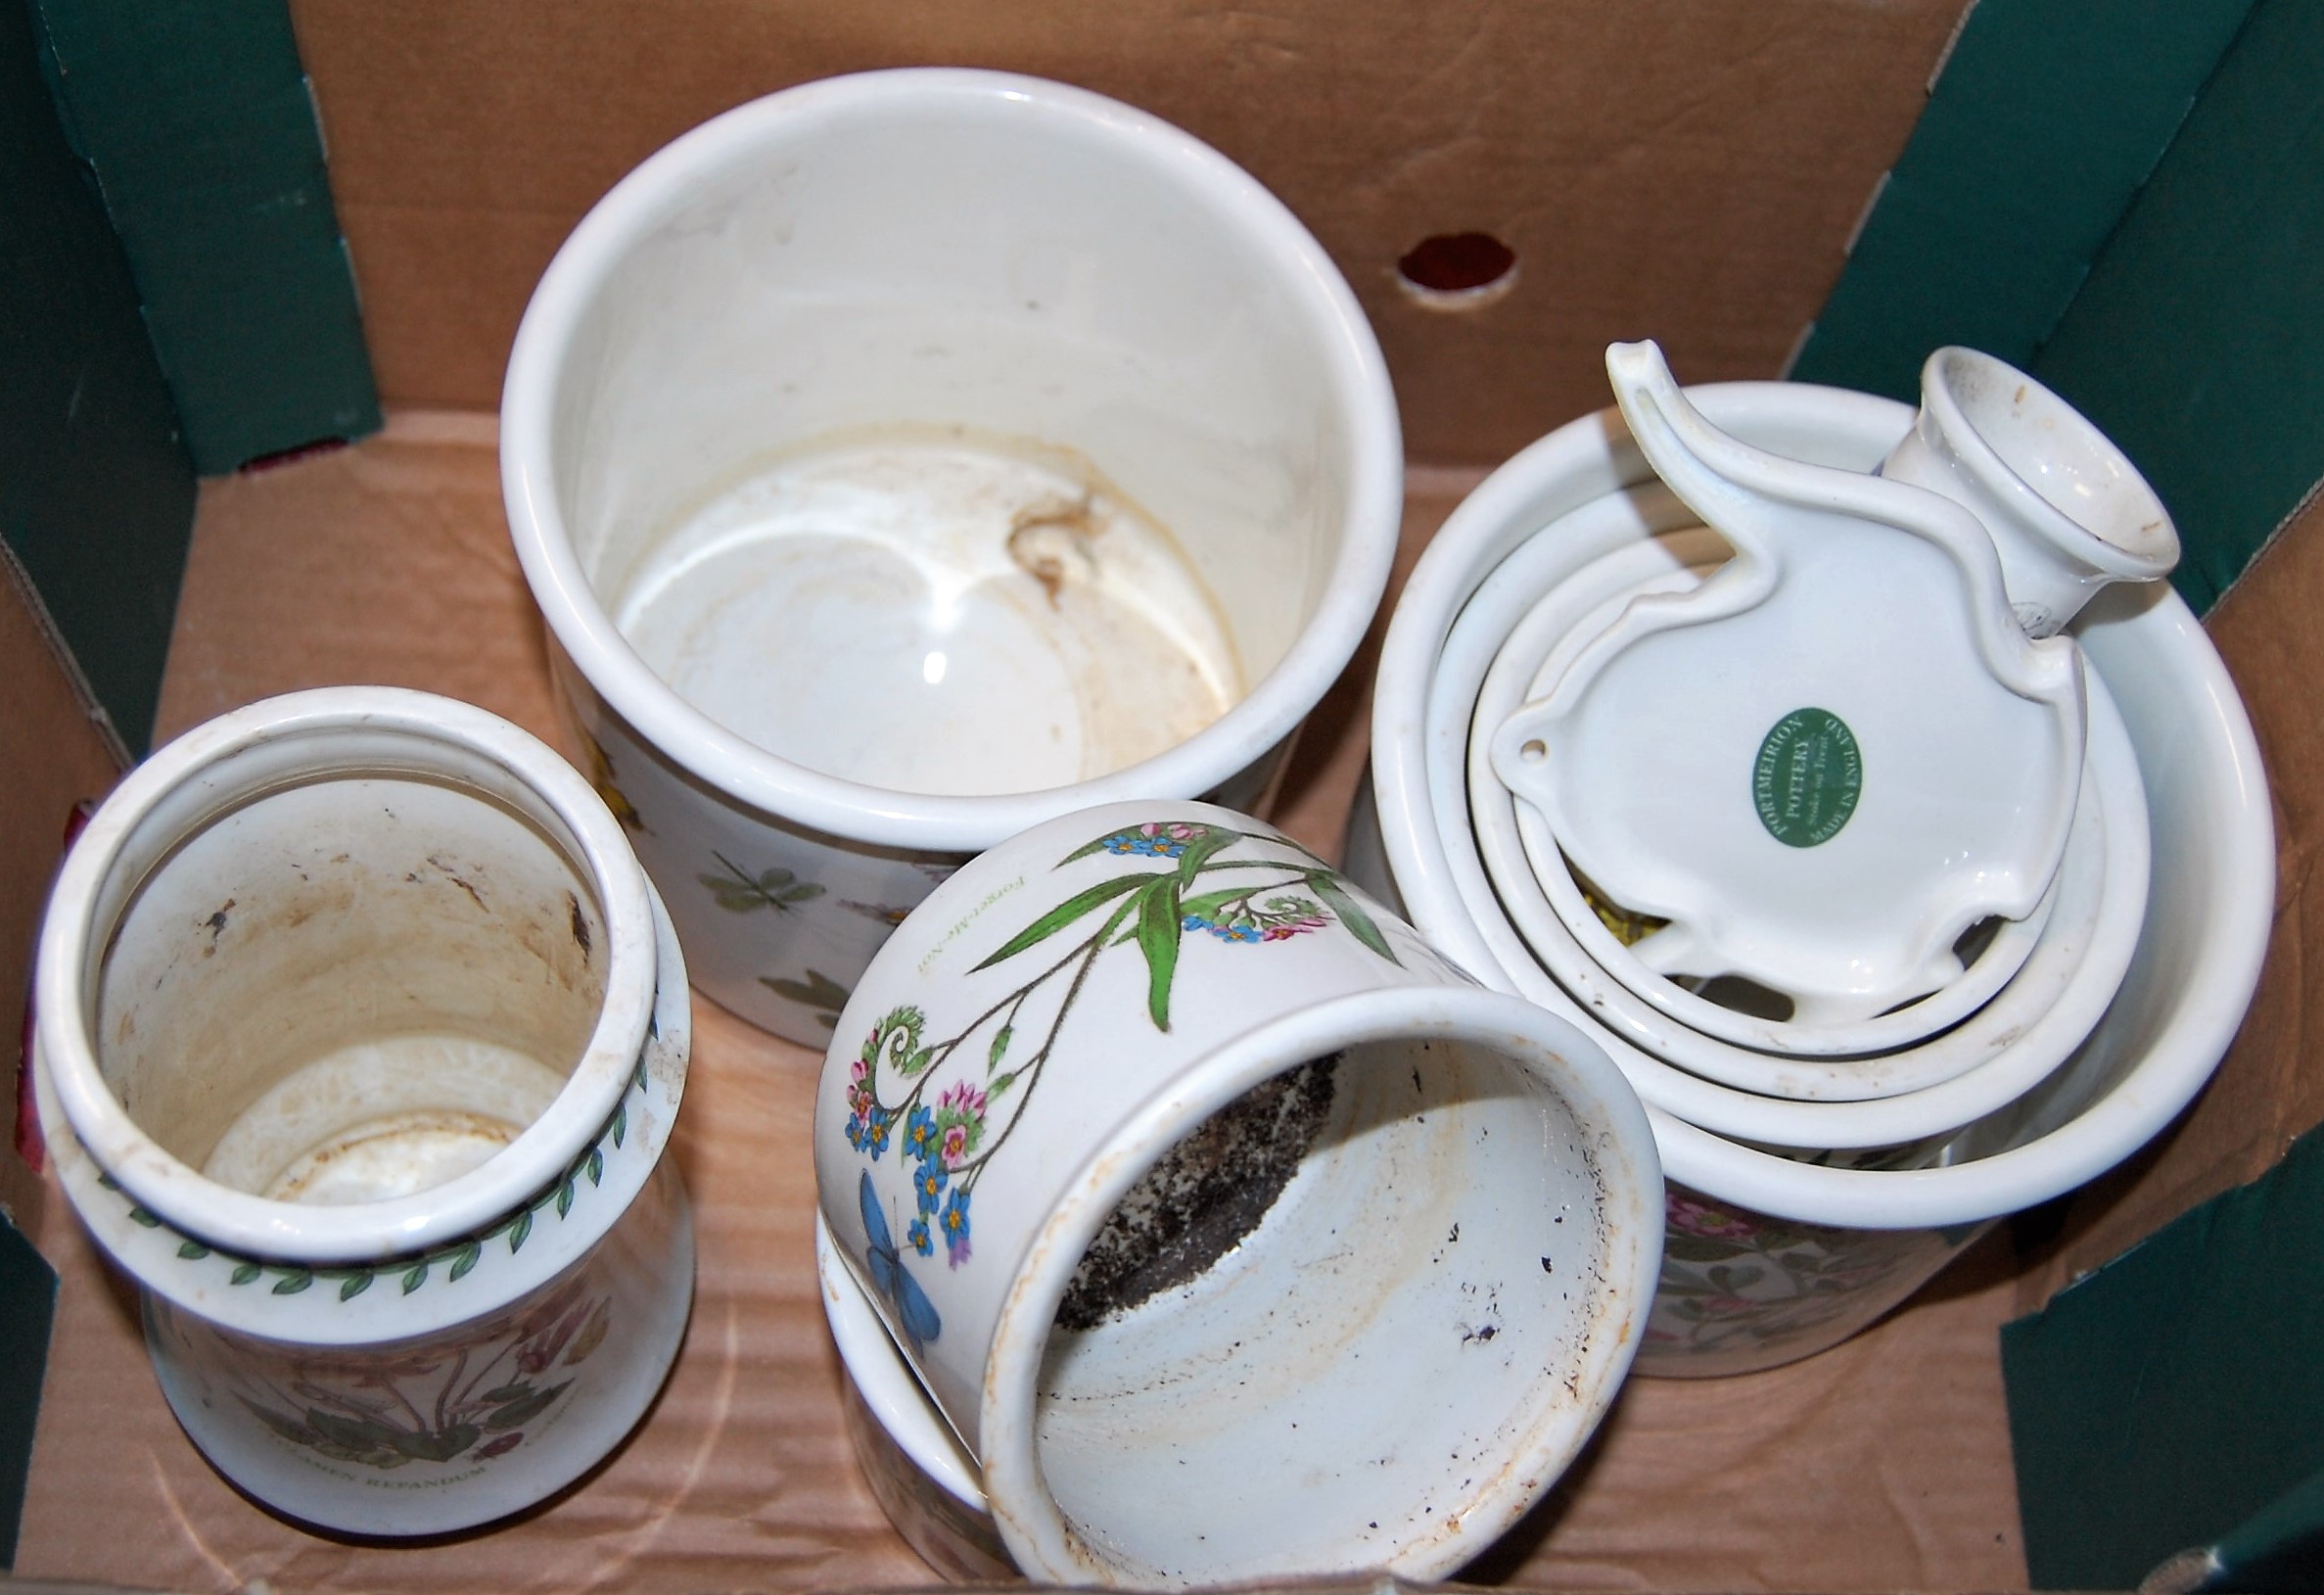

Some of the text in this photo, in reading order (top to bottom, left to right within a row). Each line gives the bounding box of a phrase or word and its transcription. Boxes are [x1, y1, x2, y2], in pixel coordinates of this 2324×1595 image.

[1757, 715, 1804, 835] PORTMEIRION
[1786, 738, 1809, 818] POTTERY
[1809, 719, 1858, 843] MADE IN ENGLAND
[365, 1466, 488, 1490] REPANDUM
